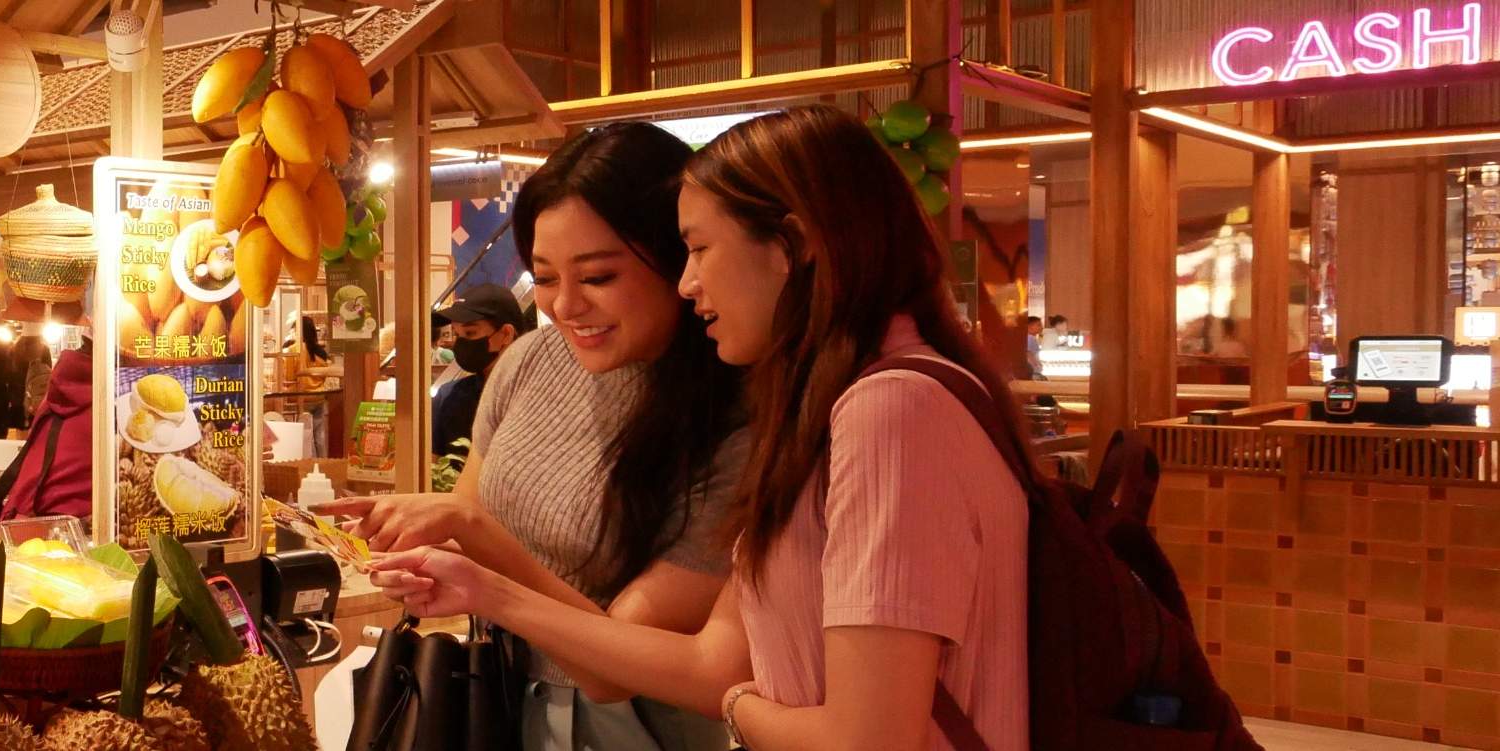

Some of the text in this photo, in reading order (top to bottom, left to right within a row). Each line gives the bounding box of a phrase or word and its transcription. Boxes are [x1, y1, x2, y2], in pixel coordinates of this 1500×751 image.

[1211, 2, 1481, 86] CASH
[127, 193, 211, 212] Taste of Asian
[122, 217, 176, 242] Mango
[122, 245, 169, 270] Sticky
[122, 274, 156, 293] Rice
[134, 334, 228, 360] 芒果糯米饭
[195, 376, 244, 395] Durian
[200, 404, 244, 425] Sticky
[213, 431, 244, 449] Rice
[134, 511, 227, 542] 榴莲糯米饭
